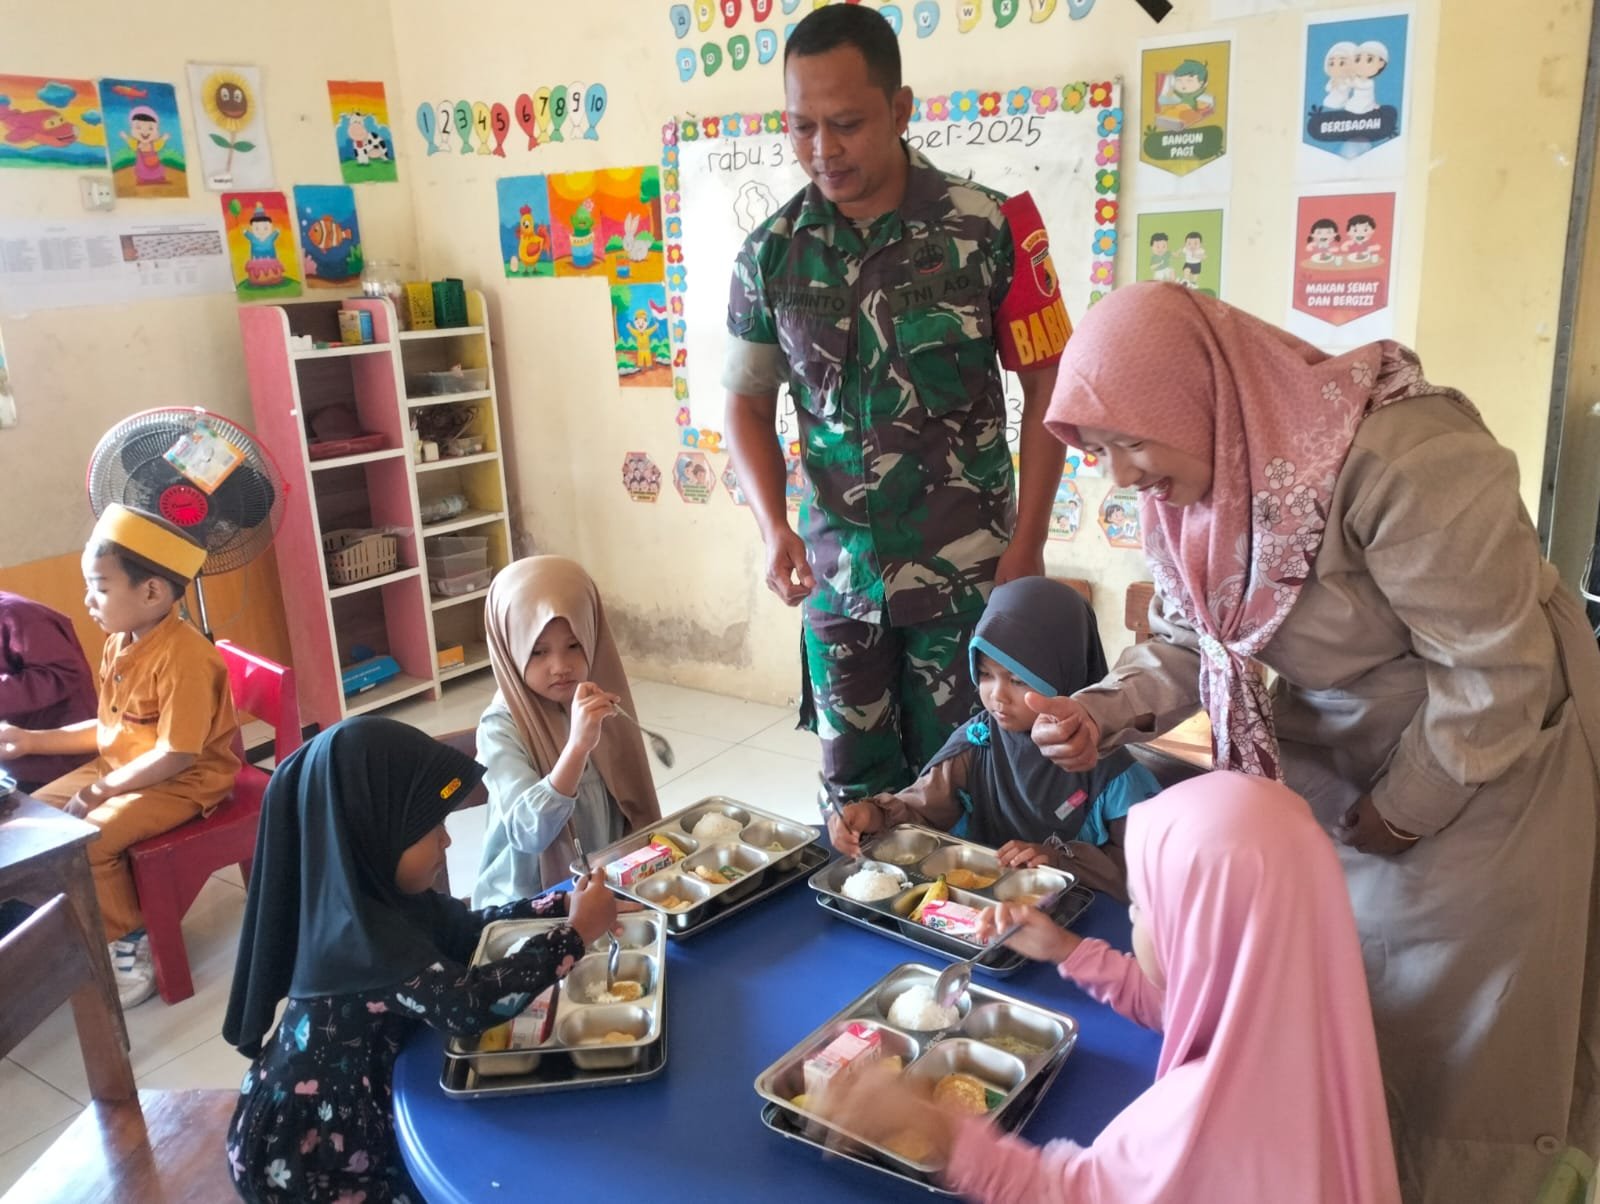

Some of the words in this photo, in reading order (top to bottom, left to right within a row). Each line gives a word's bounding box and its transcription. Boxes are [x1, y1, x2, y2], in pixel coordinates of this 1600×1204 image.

[963, 8, 973, 16] w
[522, 106, 531, 123] 6
[539, 96, 549, 116] 7
[555, 97, 566, 117] 8
[572, 92, 581, 112] 9
[590, 97, 603, 113] 10
[423, 112, 429, 133] 1
[441, 110, 450, 134] 2
[456, 109, 468, 129] 3
[478, 111, 487, 130] 4
[497, 113, 506, 131] 5
[1320, 118, 1381, 133] BERIBADAH
[1162, 132, 1203, 146] BANGUN
[770, 143, 783, 167] 3
[1170, 146, 1194, 158] PAGI
[1306, 283, 1345, 294] MAKAN
[1347, 281, 1379, 293] SEHAT
[901, 285, 933, 306] TNI
[1308, 296, 1331, 306] DAN
[1333, 295, 1374, 306] BERGIZI
